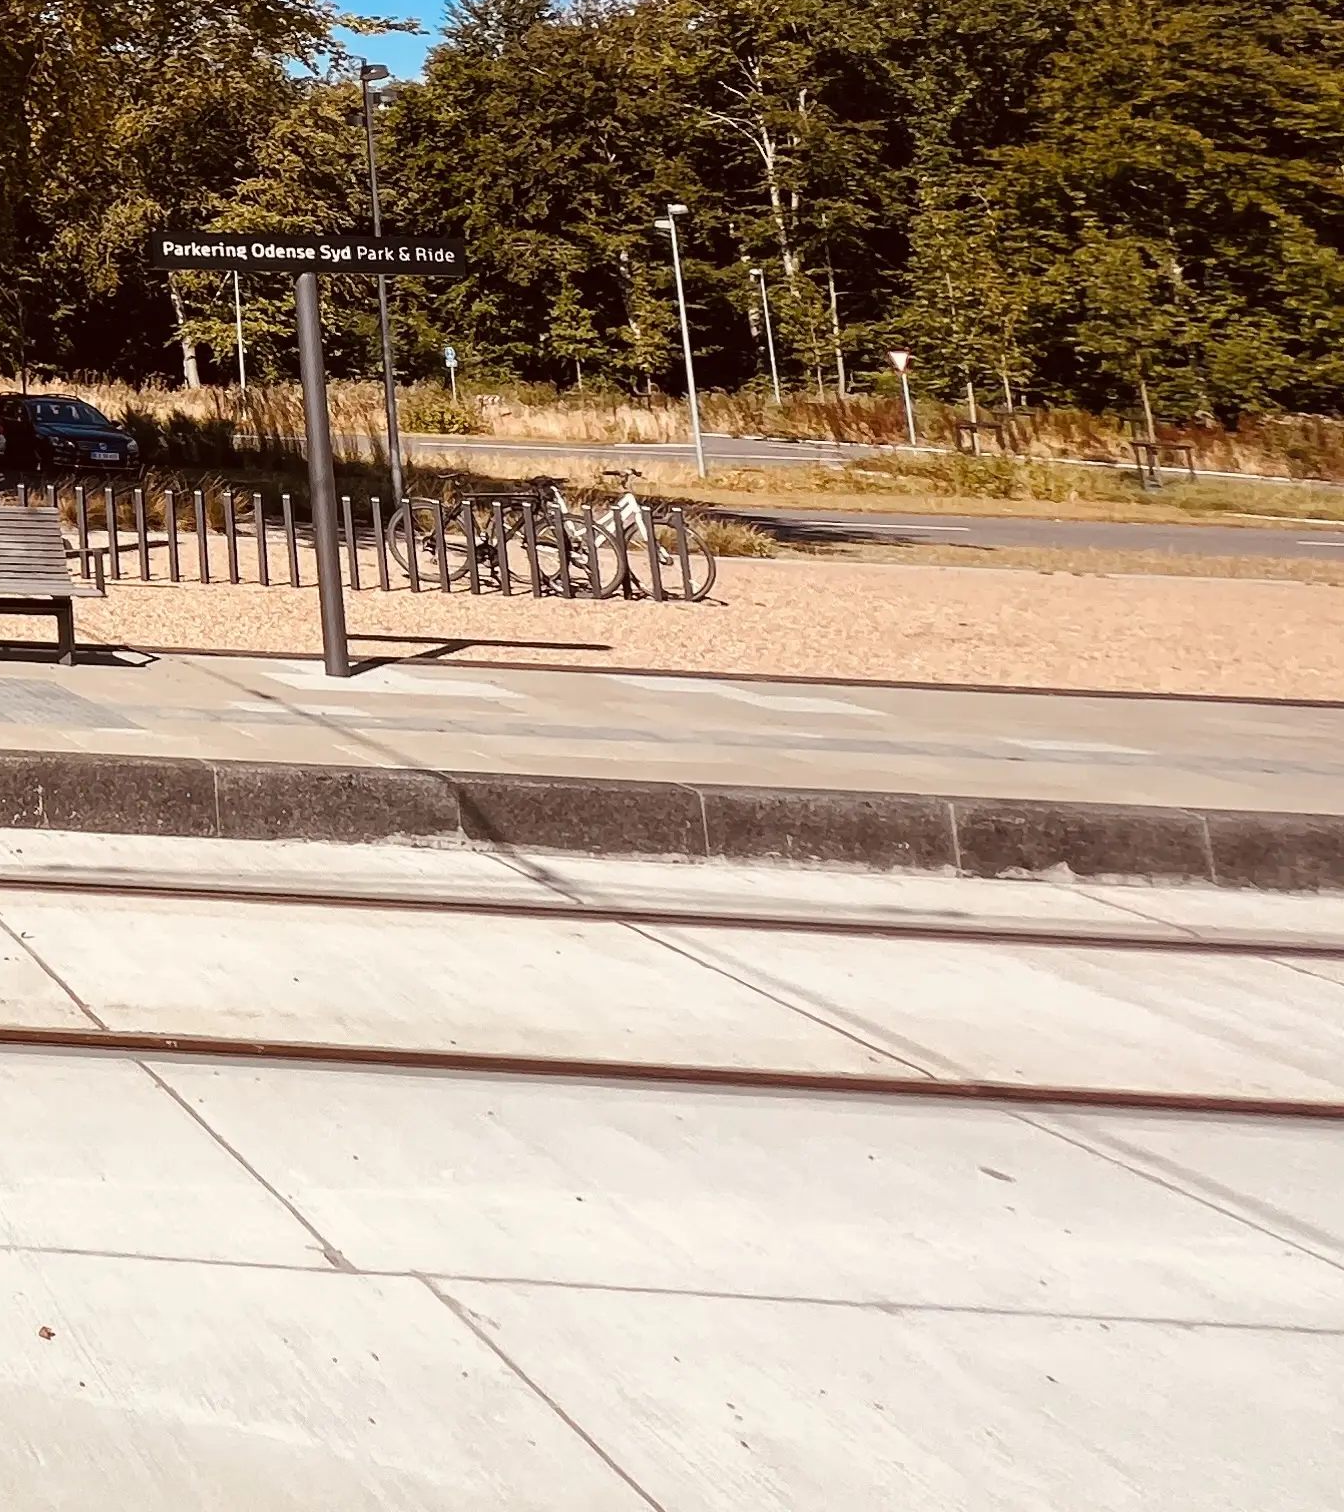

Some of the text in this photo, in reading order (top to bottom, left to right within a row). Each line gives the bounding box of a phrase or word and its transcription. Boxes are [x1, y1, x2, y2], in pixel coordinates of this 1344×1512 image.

[162, 241, 456, 263] Parkering Odense Syd Park & Ride
